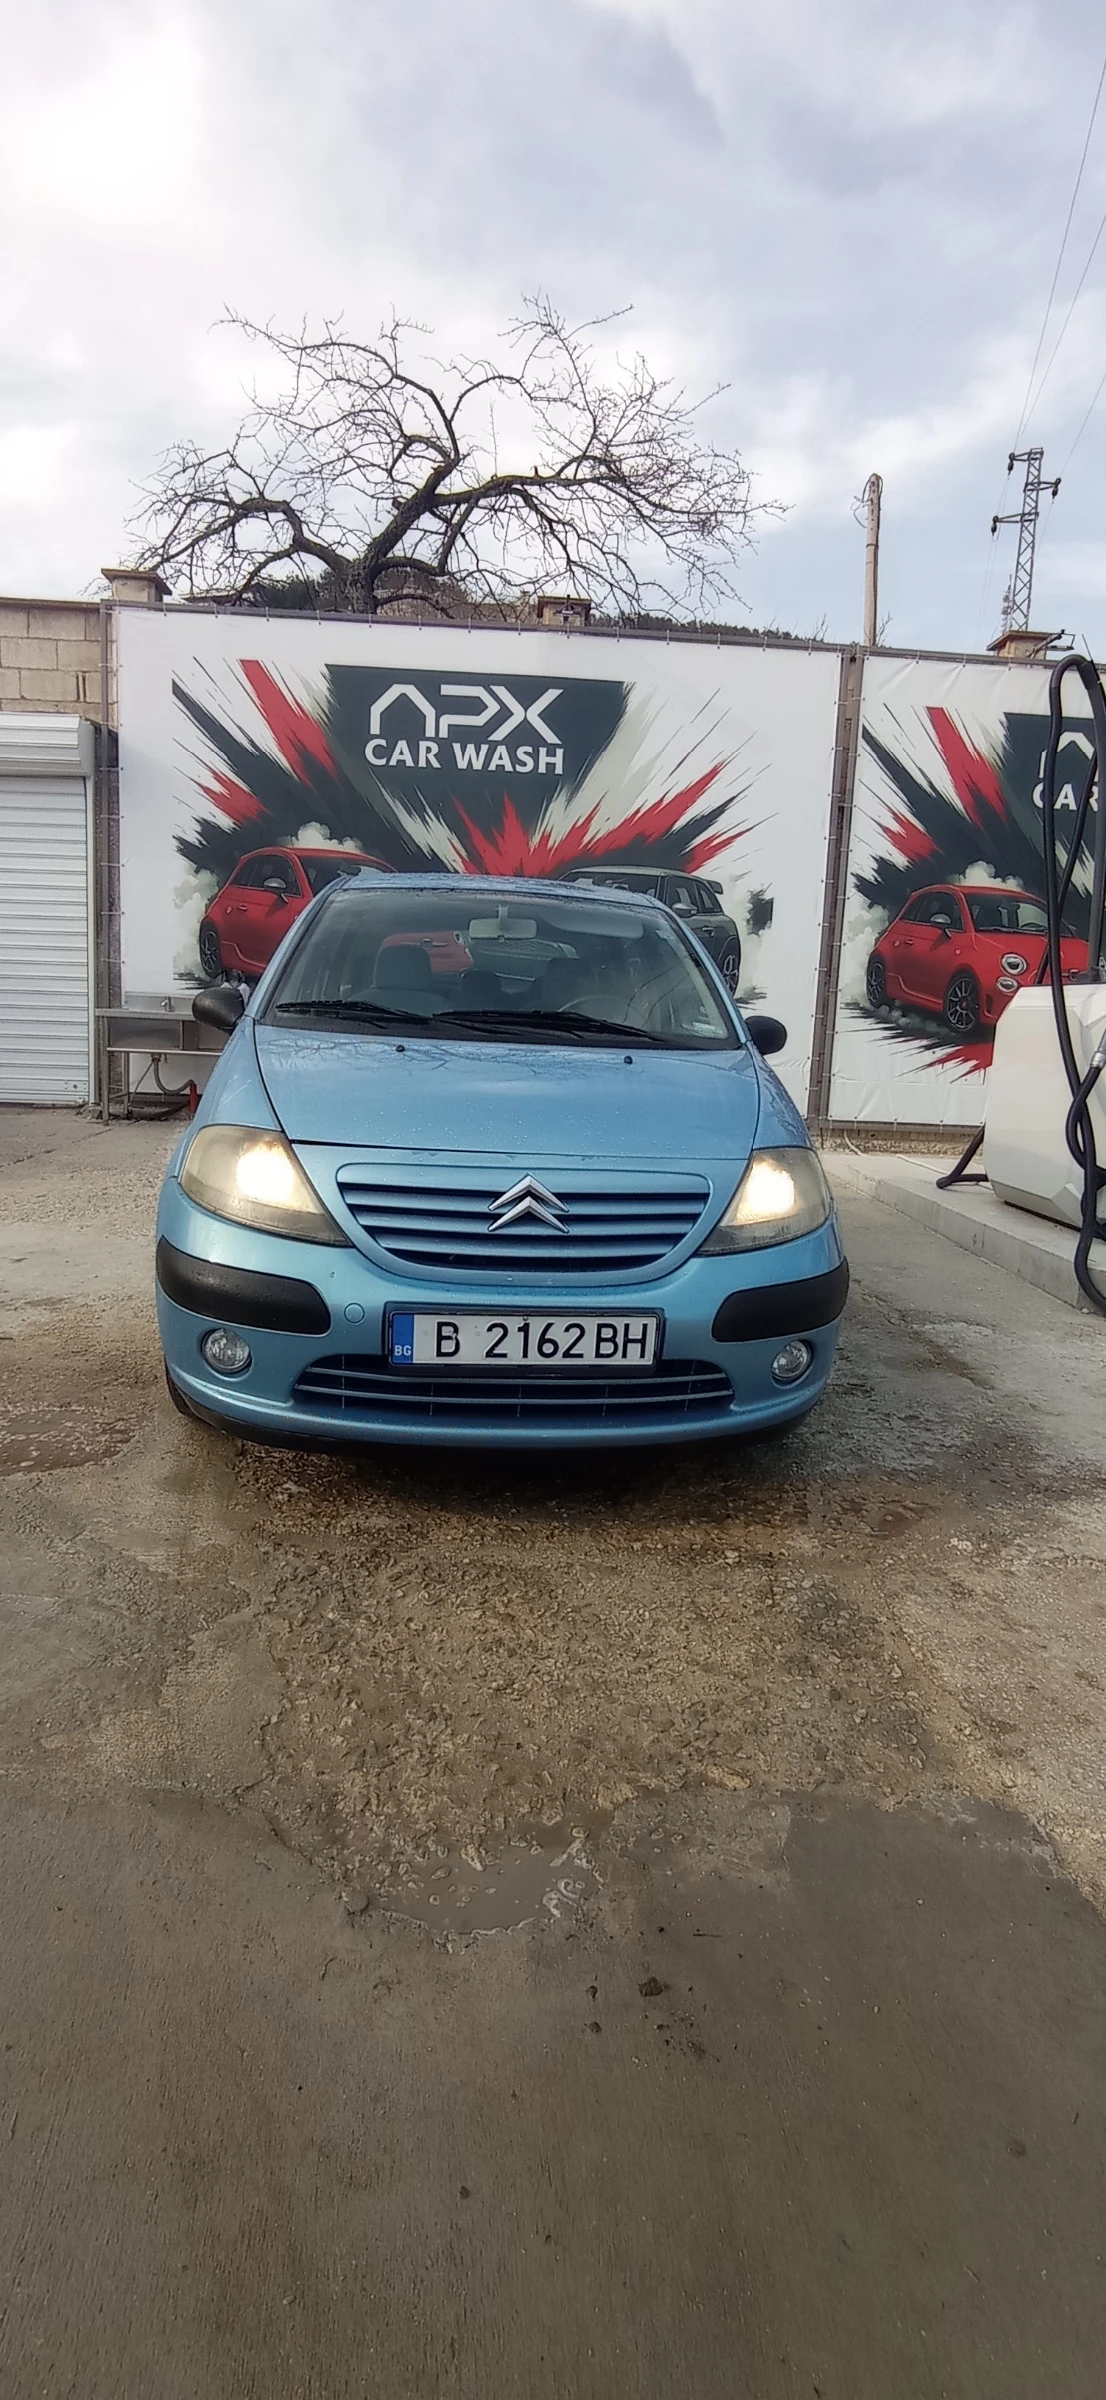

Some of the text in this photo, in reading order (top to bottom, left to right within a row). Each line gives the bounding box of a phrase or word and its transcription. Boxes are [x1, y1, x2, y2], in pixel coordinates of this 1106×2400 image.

[370, 683, 564, 744] APX
[364, 738, 565, 775] CAR WASH
[394, 1345, 412, 1356] BG
